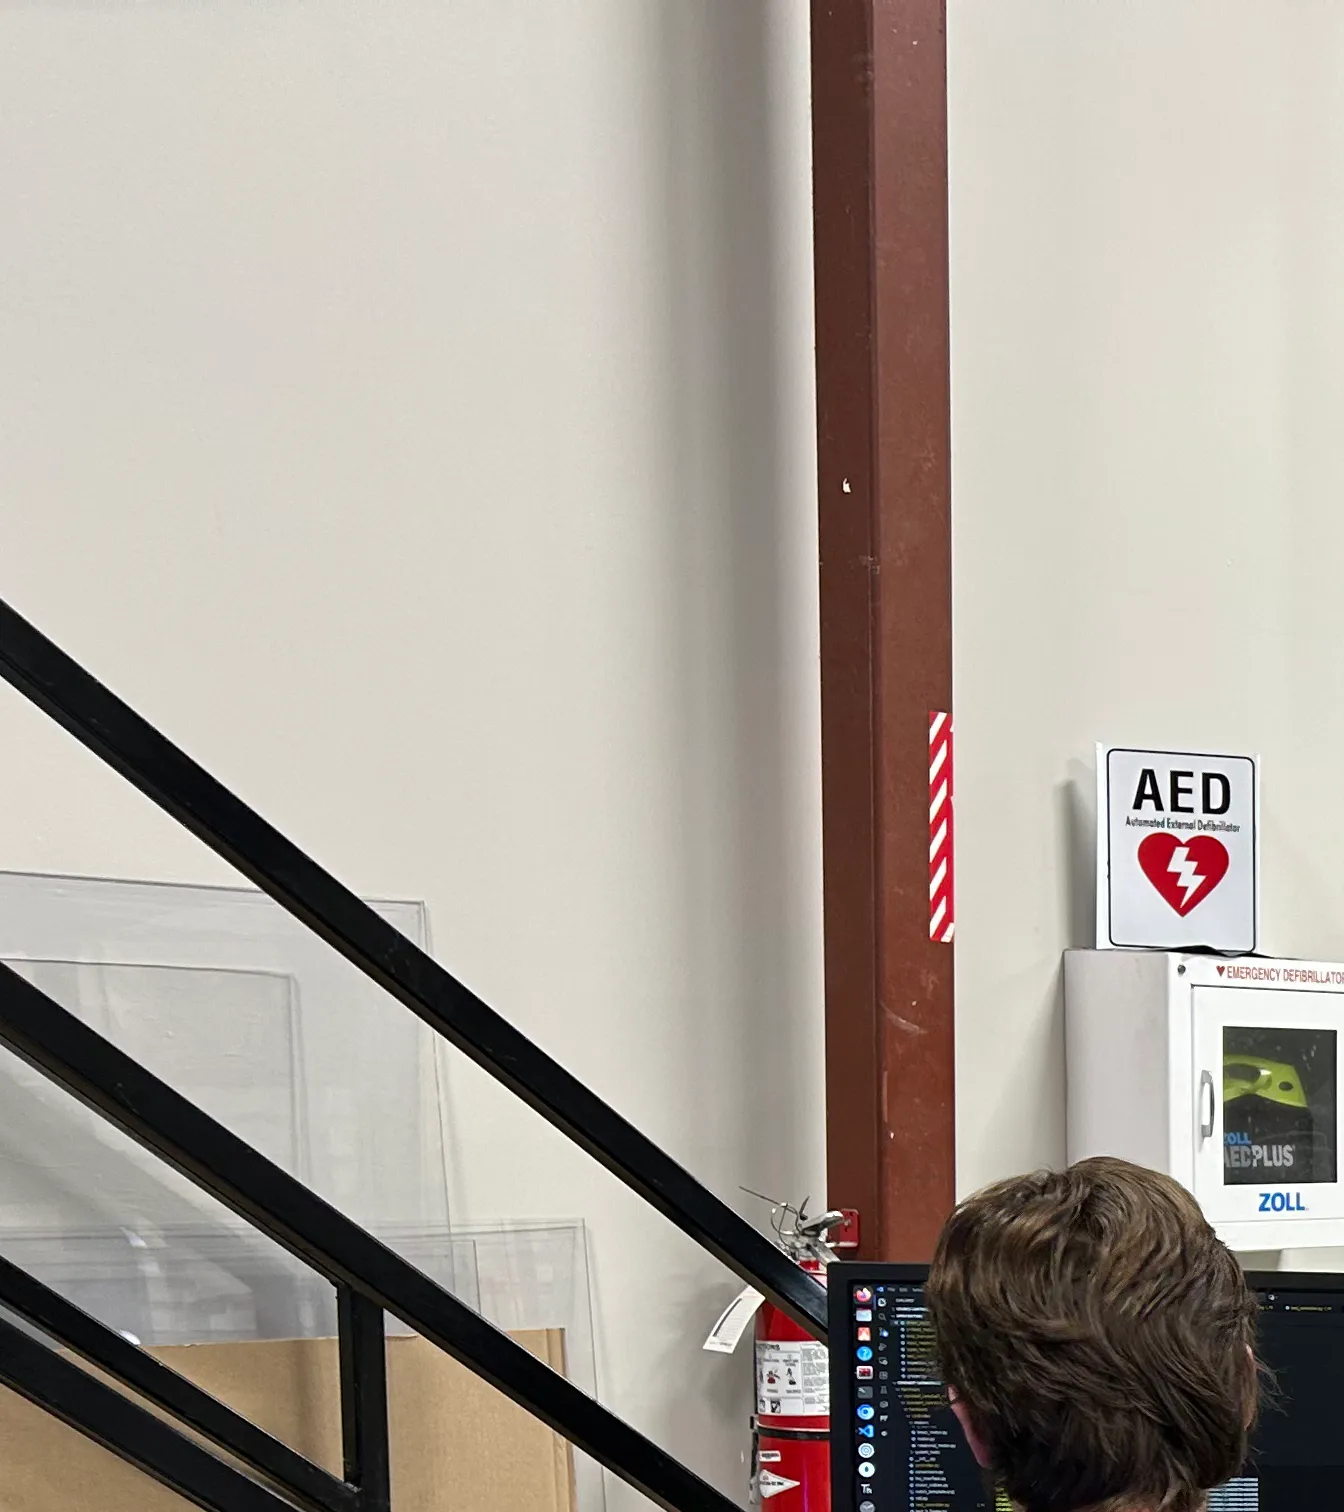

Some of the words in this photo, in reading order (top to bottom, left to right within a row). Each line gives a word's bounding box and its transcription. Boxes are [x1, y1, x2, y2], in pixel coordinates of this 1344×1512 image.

[1132, 768, 1231, 815] AED
[1125, 816, 1165, 829] Automated
[1166, 818, 1196, 830] External
[1197, 820, 1241, 832] Defibrillator
[1227, 965, 1281, 981] EMERGENCY
[1259, 1191, 1306, 1212] ZOLL
